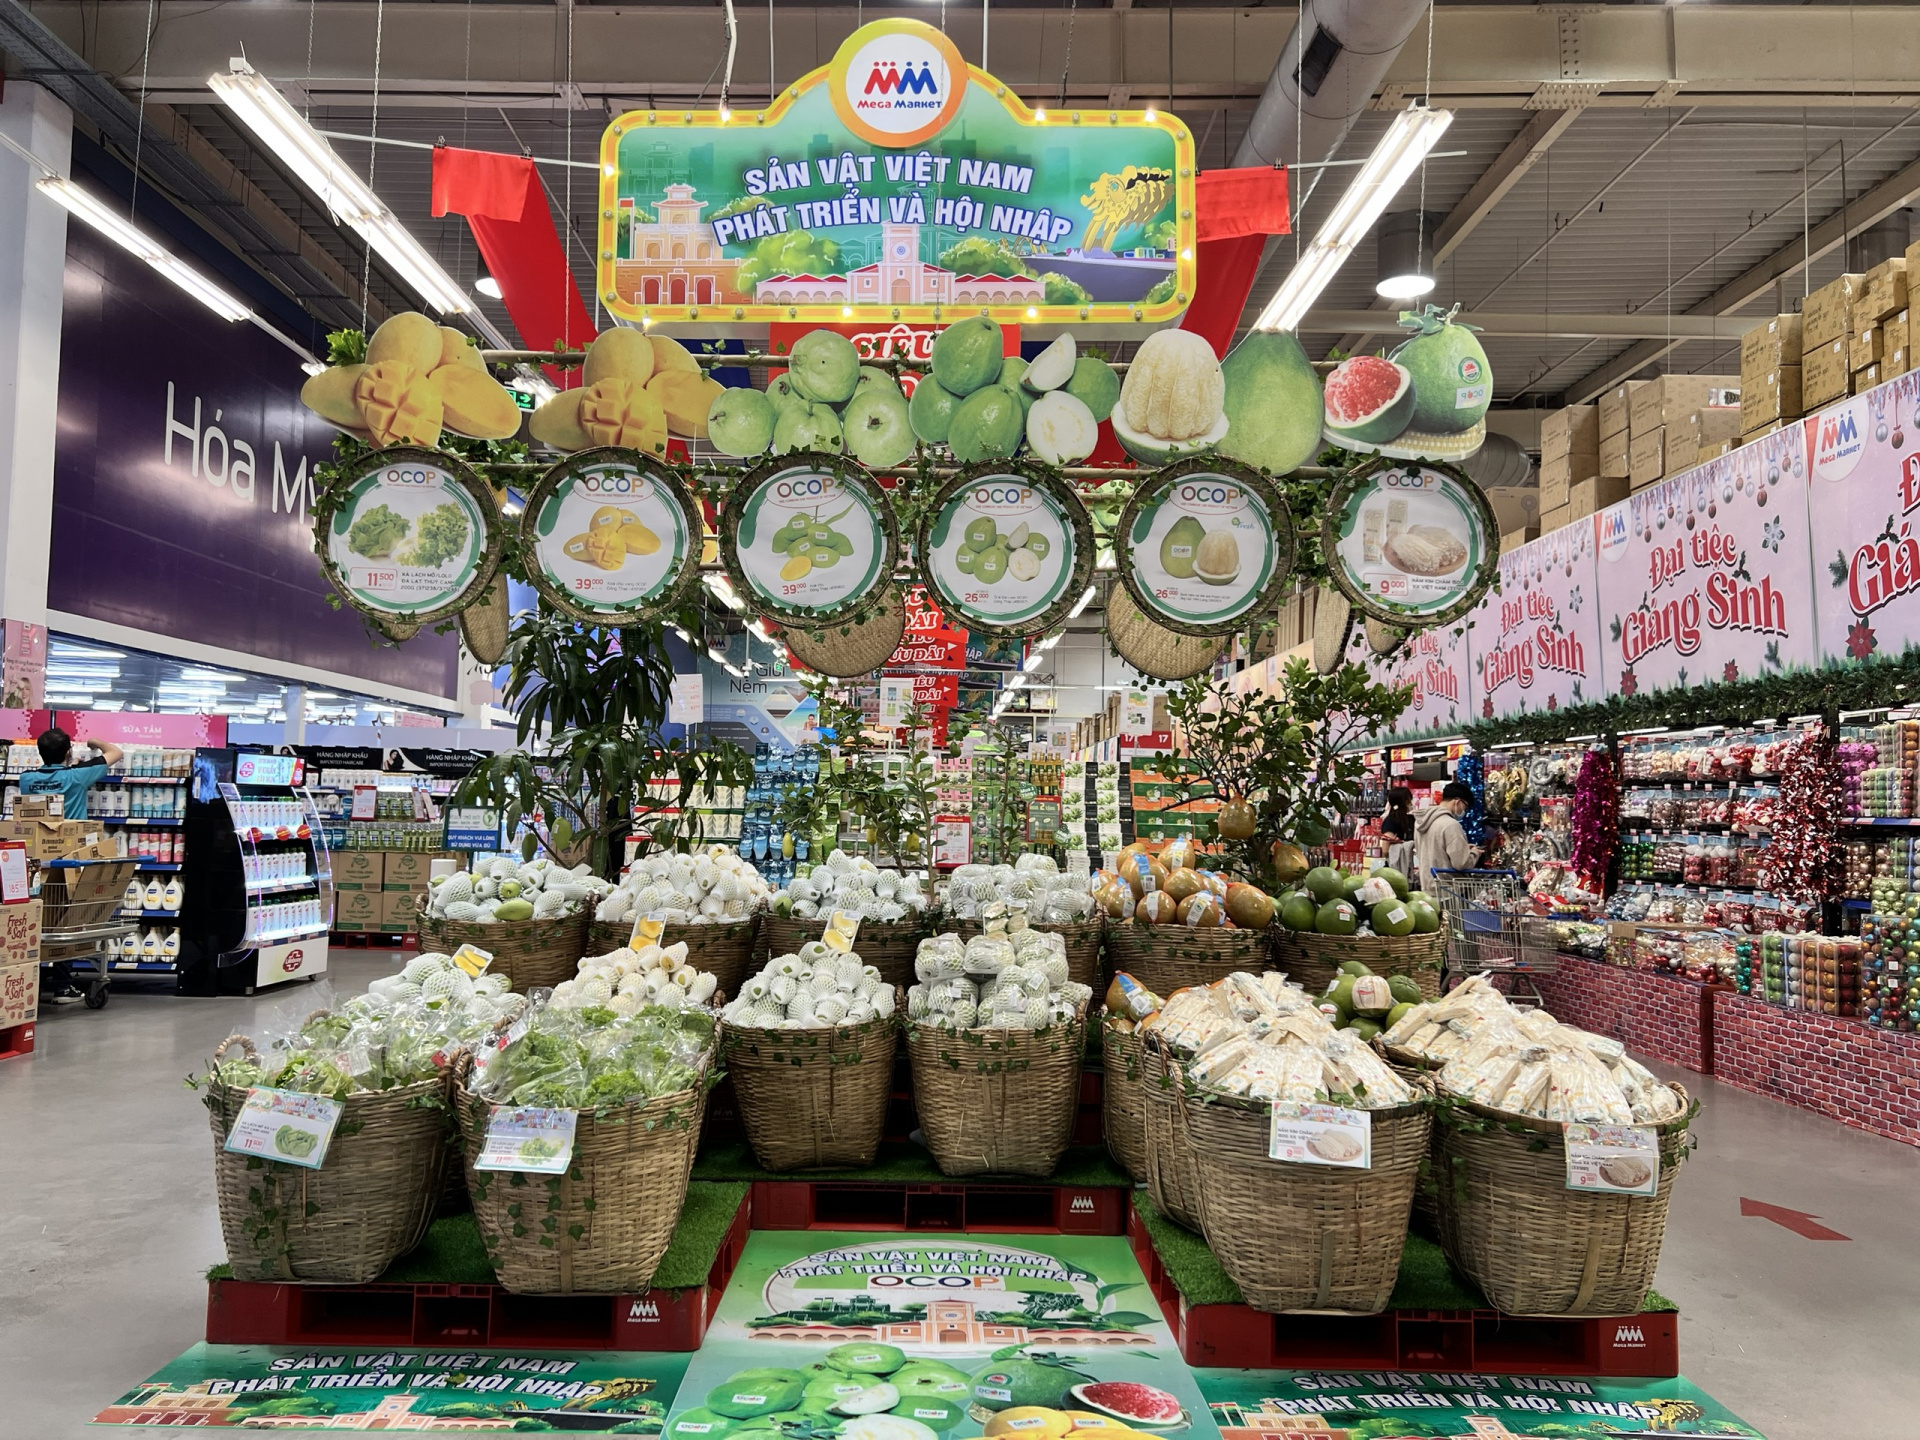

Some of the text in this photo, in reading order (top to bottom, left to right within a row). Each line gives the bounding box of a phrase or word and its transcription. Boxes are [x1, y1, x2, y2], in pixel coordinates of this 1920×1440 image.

[745, 151, 1034, 195] SẢN VẬT VIỆT NAM
[713, 188, 1073, 247] PHÁT TRIỂN VÀ HỘI NHẬP
[164, 380, 256, 503] Hóa
[387, 470, 436, 484] OCOP
[585, 477, 644, 492] OCOP
[1387, 474, 1434, 488] OCOP
[777, 478, 834, 498] OCOP
[975, 488, 1033, 504] OCOP
[1181, 486, 1238, 504] OCOP
[1650, 524, 1736, 592] Đại tiệc
[1848, 523, 1920, 617] Giá
[1622, 571, 1788, 665] Giáng Sinh
[1483, 636, 1534, 694] Giáng
[1536, 625, 1586, 678] Sinh
[730, 679, 767, 696] Nệm
[912, 675, 936, 688] IÊU
[1425, 658, 1459, 704] Sinh
[1158, 734, 1169, 743] 17
[7, 912, 28, 927] Fresh
[12, 926, 28, 939] Soft
[5, 972, 25, 987] Fresh
[10, 986, 25, 1000] Soft
[808, 1250, 1052, 1267] SẢN VẬT VIỆT NAM
[777, 1259, 1088, 1282] PHÁT TRIỂN VÀ HỘI NHẬP
[870, 1275, 1000, 1288] OCOP
[269, 1352, 580, 1375] SẢN VẬT VIỆT NAM
[208, 1368, 604, 1400] PHÁT TRIỂN VÀ HỘI NHẬP
[1292, 1371, 1596, 1396] SẢN VẬT VIỆT NAM
[1274, 1394, 1356, 1415] PHÁT
[1355, 1387, 1453, 1409] TRIỂN
[1451, 1392, 1502, 1409] VÀ
[1566, 1399, 1662, 1421] NHẬP
